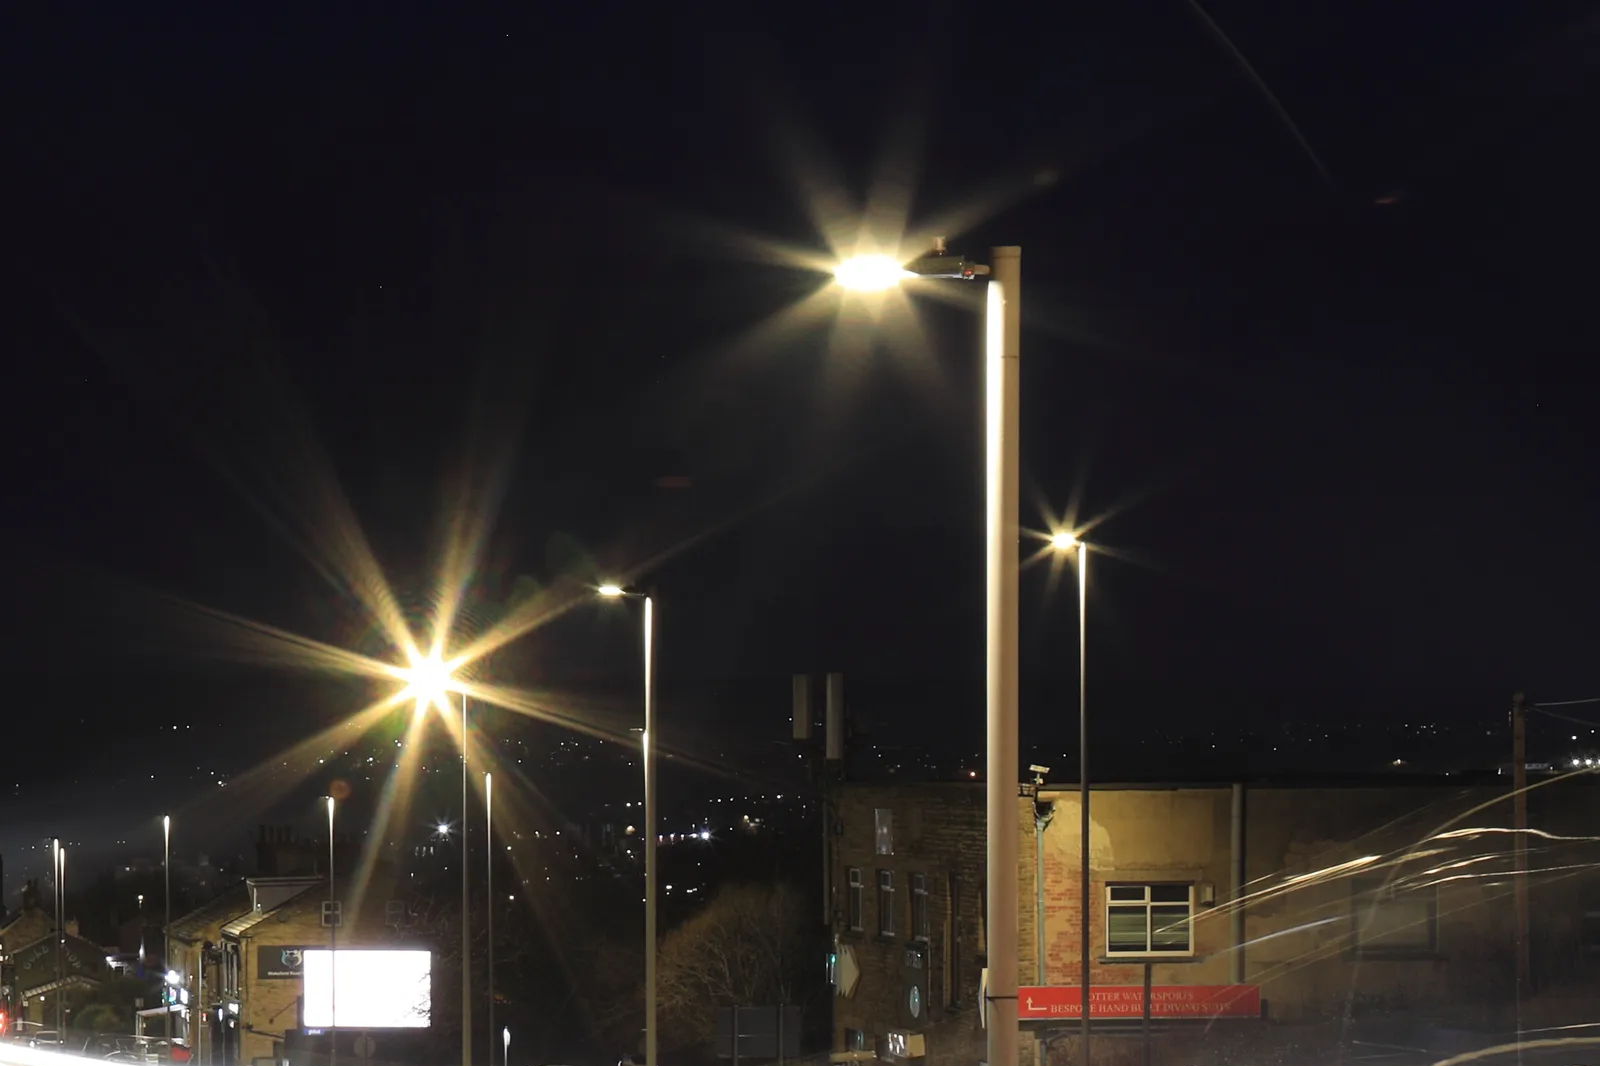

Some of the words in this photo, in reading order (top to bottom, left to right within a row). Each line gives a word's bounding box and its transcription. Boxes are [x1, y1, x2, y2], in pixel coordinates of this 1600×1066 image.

[1122, 992, 1194, 1001] WATRSPORTS
[1051, 1004, 1097, 1013] BESPOE
[1099, 1004, 1128, 1013] HAND
[1131, 1003, 1163, 1012] BULT
[1164, 1003, 1201, 1012] DIVING
